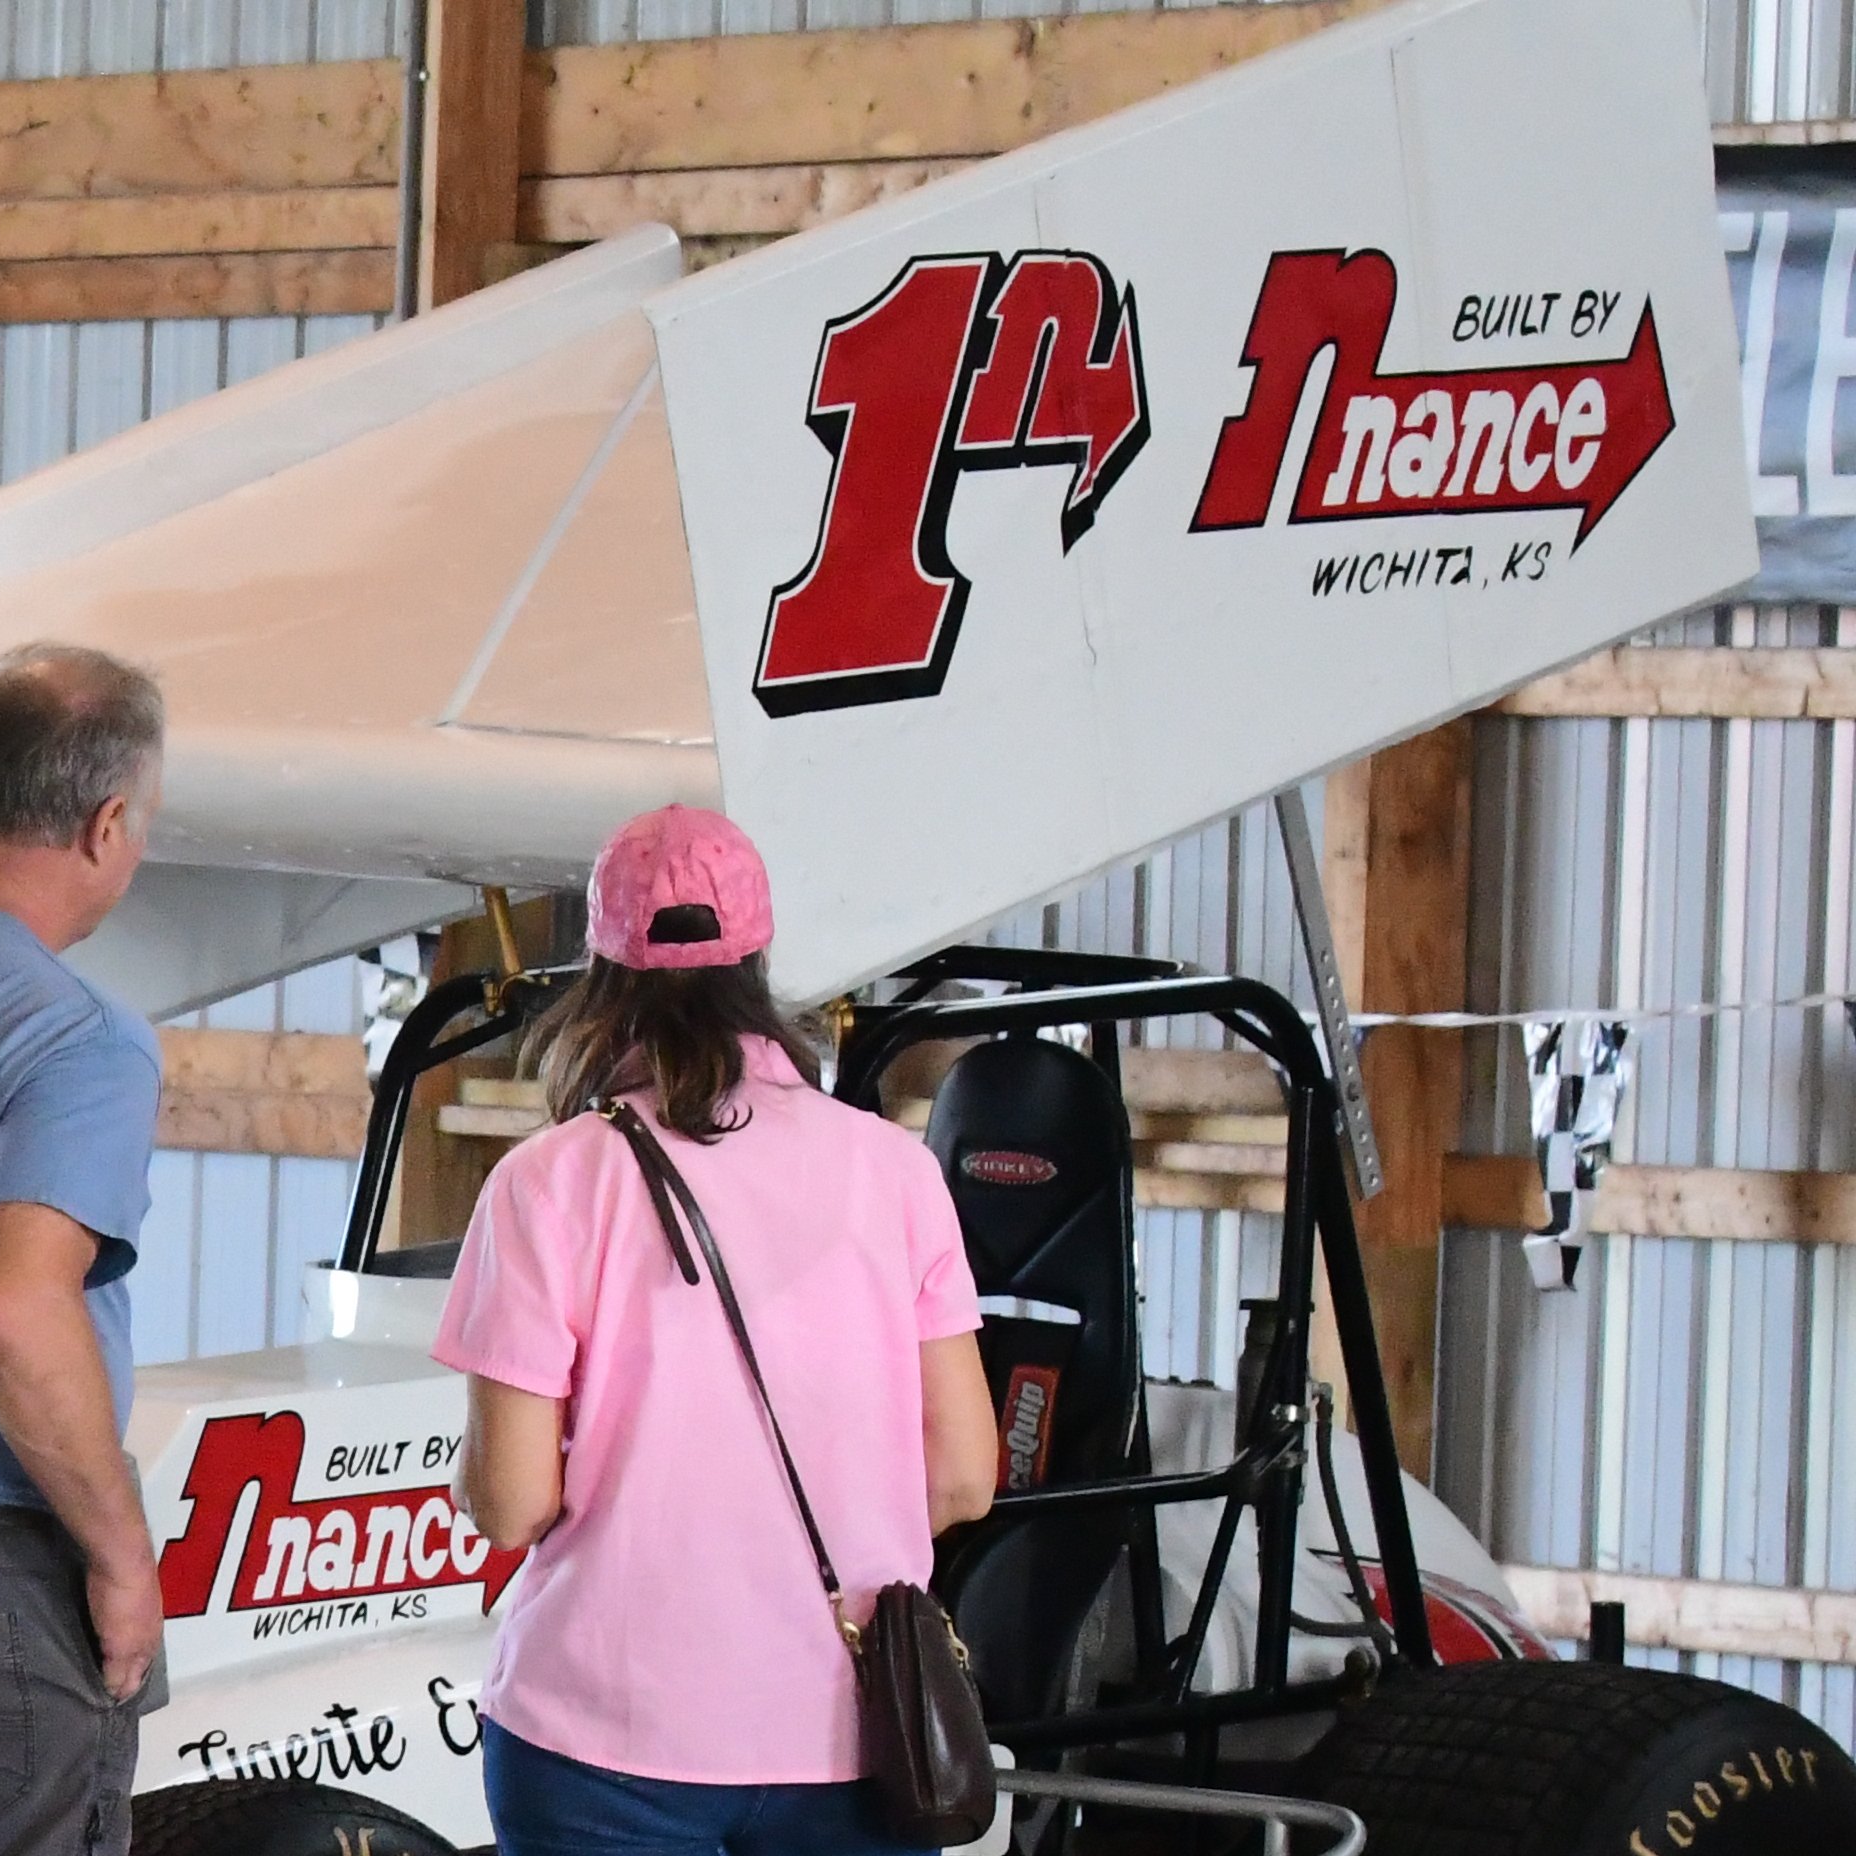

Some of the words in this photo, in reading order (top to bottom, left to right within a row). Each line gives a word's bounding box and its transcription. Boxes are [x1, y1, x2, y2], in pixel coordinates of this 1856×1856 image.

[1452, 292, 1562, 342] BUILT
[1570, 289, 1622, 338] BY
[1322, 377, 1608, 507] nance
[1501, 541, 1553, 583] KS
[326, 1440, 412, 1482] BUILT
[423, 1435, 463, 1470] BY
[390, 1593, 428, 1620] KS
